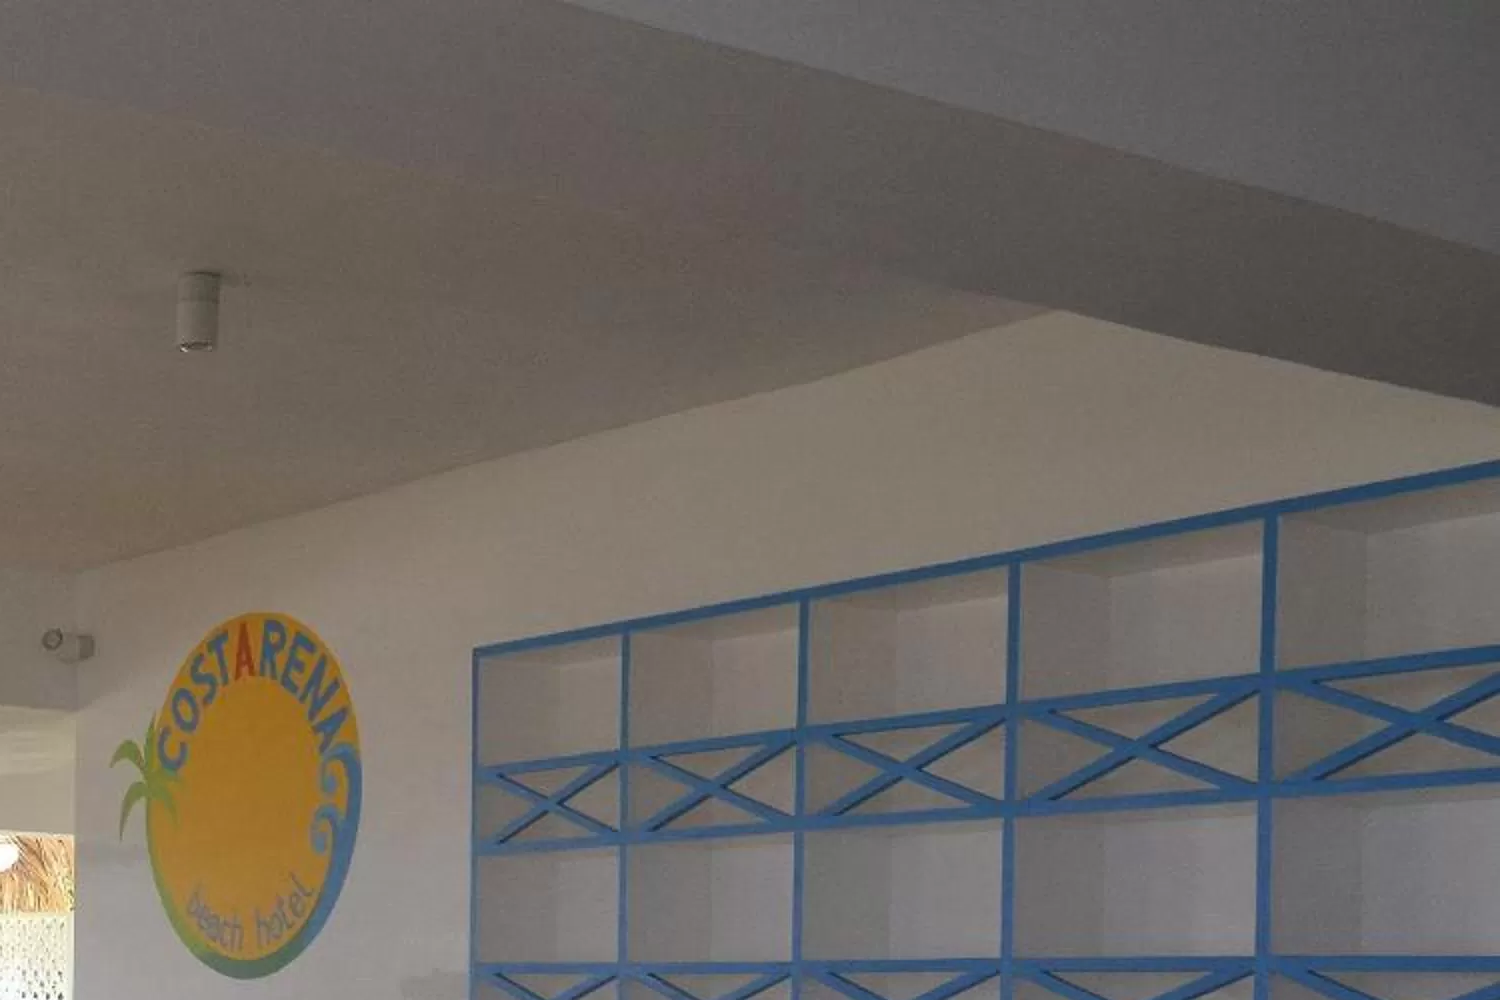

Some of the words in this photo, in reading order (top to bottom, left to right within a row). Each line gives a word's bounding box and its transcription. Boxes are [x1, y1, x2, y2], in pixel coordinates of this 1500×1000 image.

[157, 619, 350, 773] COSTARENA
[187, 882, 244, 951] beach
[254, 871, 314, 951] hotel
